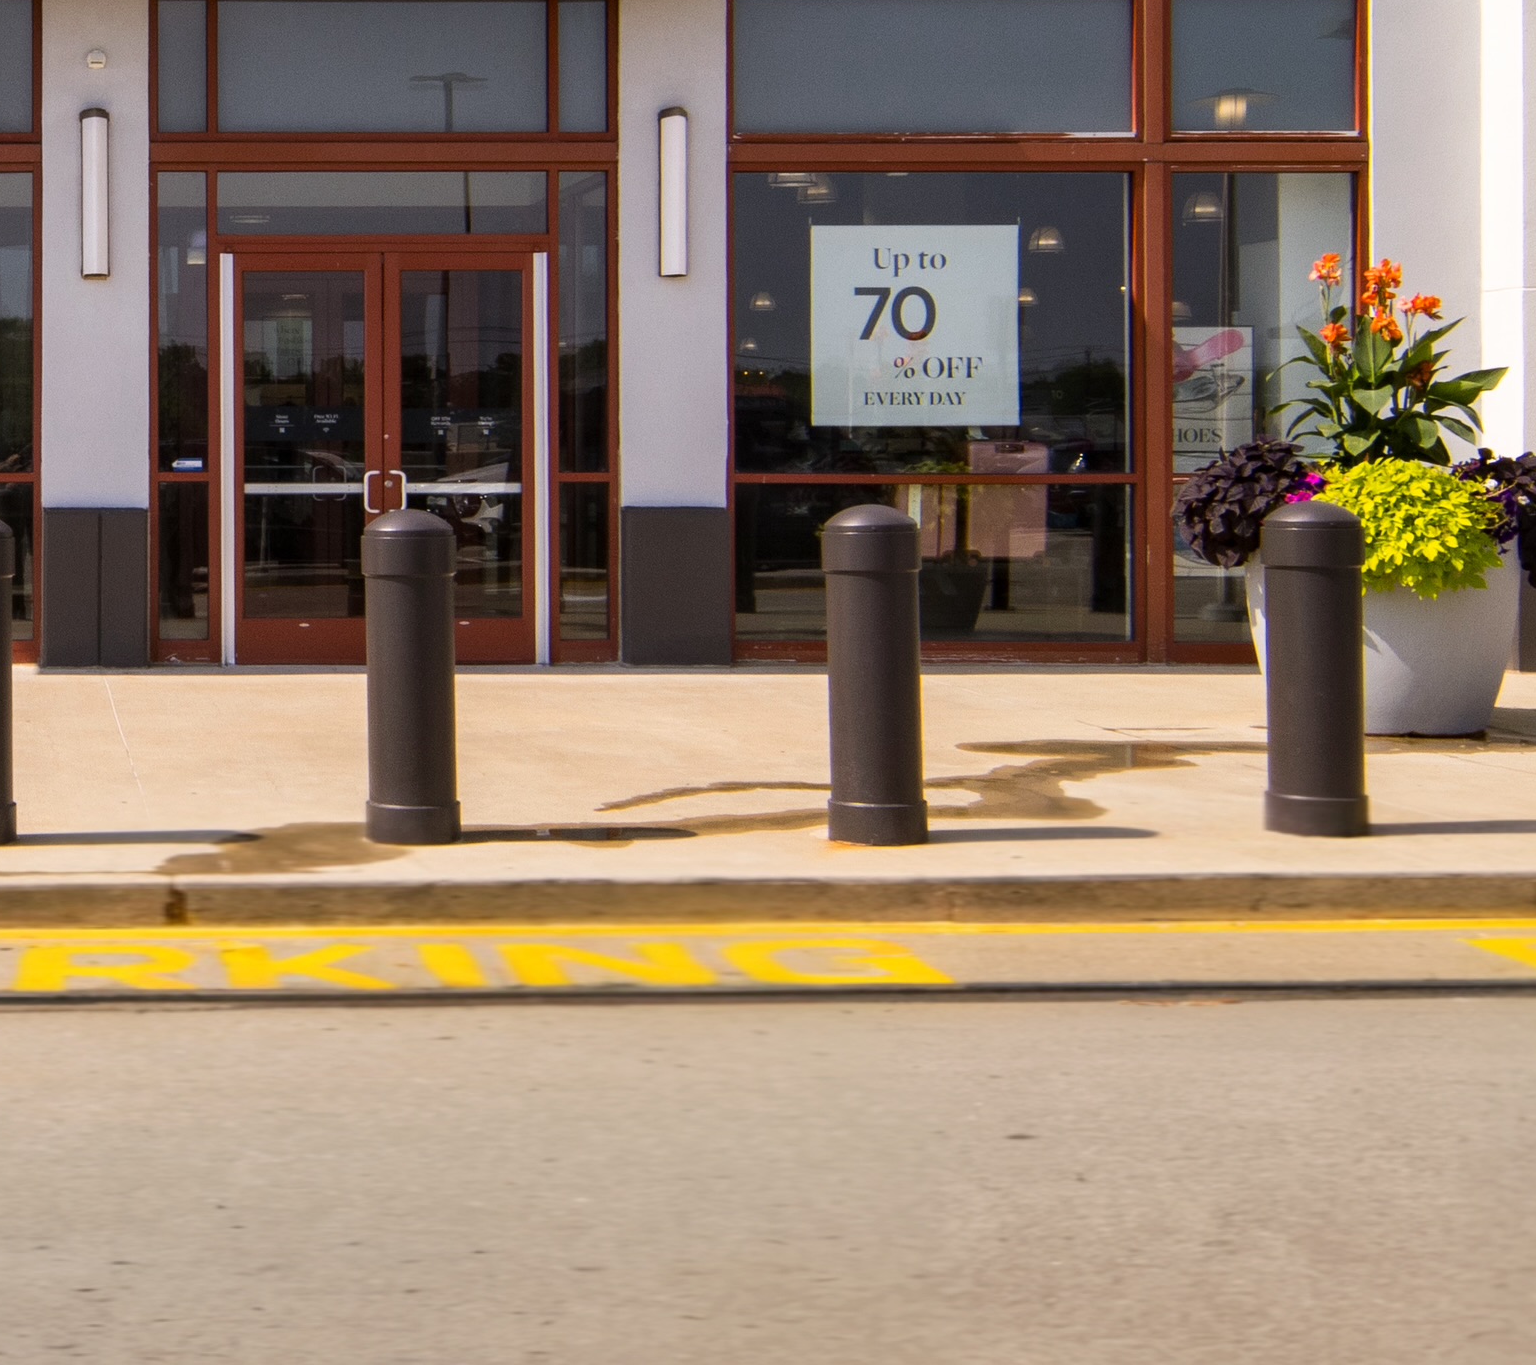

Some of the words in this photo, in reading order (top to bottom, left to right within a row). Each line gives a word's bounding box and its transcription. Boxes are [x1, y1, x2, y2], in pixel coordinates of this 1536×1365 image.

[872, 247, 910, 278] Up
[918, 251, 948, 270] to
[853, 285, 938, 342] 70
[922, 356, 984, 379] OFF
[863, 391, 925, 407] EVERY
[929, 391, 967, 407] DAY
